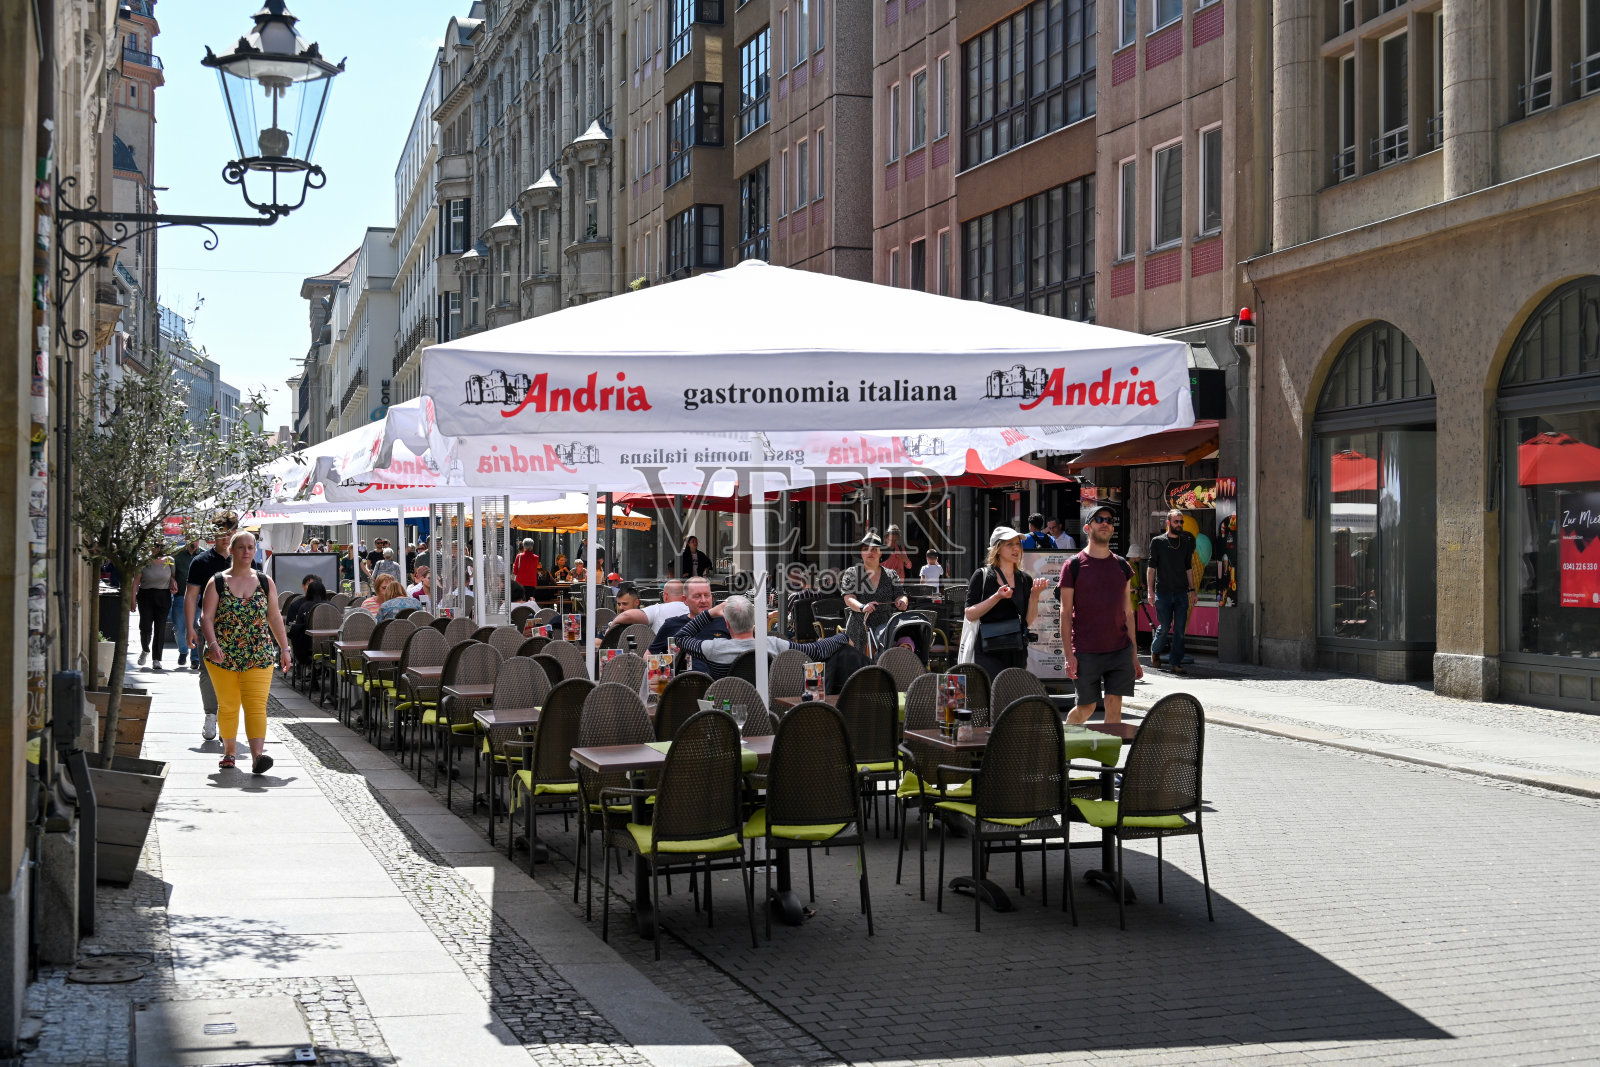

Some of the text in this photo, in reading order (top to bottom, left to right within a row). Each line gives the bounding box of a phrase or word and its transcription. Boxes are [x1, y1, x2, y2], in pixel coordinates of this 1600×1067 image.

[500, 371, 653, 418] Andria
[684, 379, 957, 411] gastronomia italiana
[1019, 366, 1159, 411] Andria
